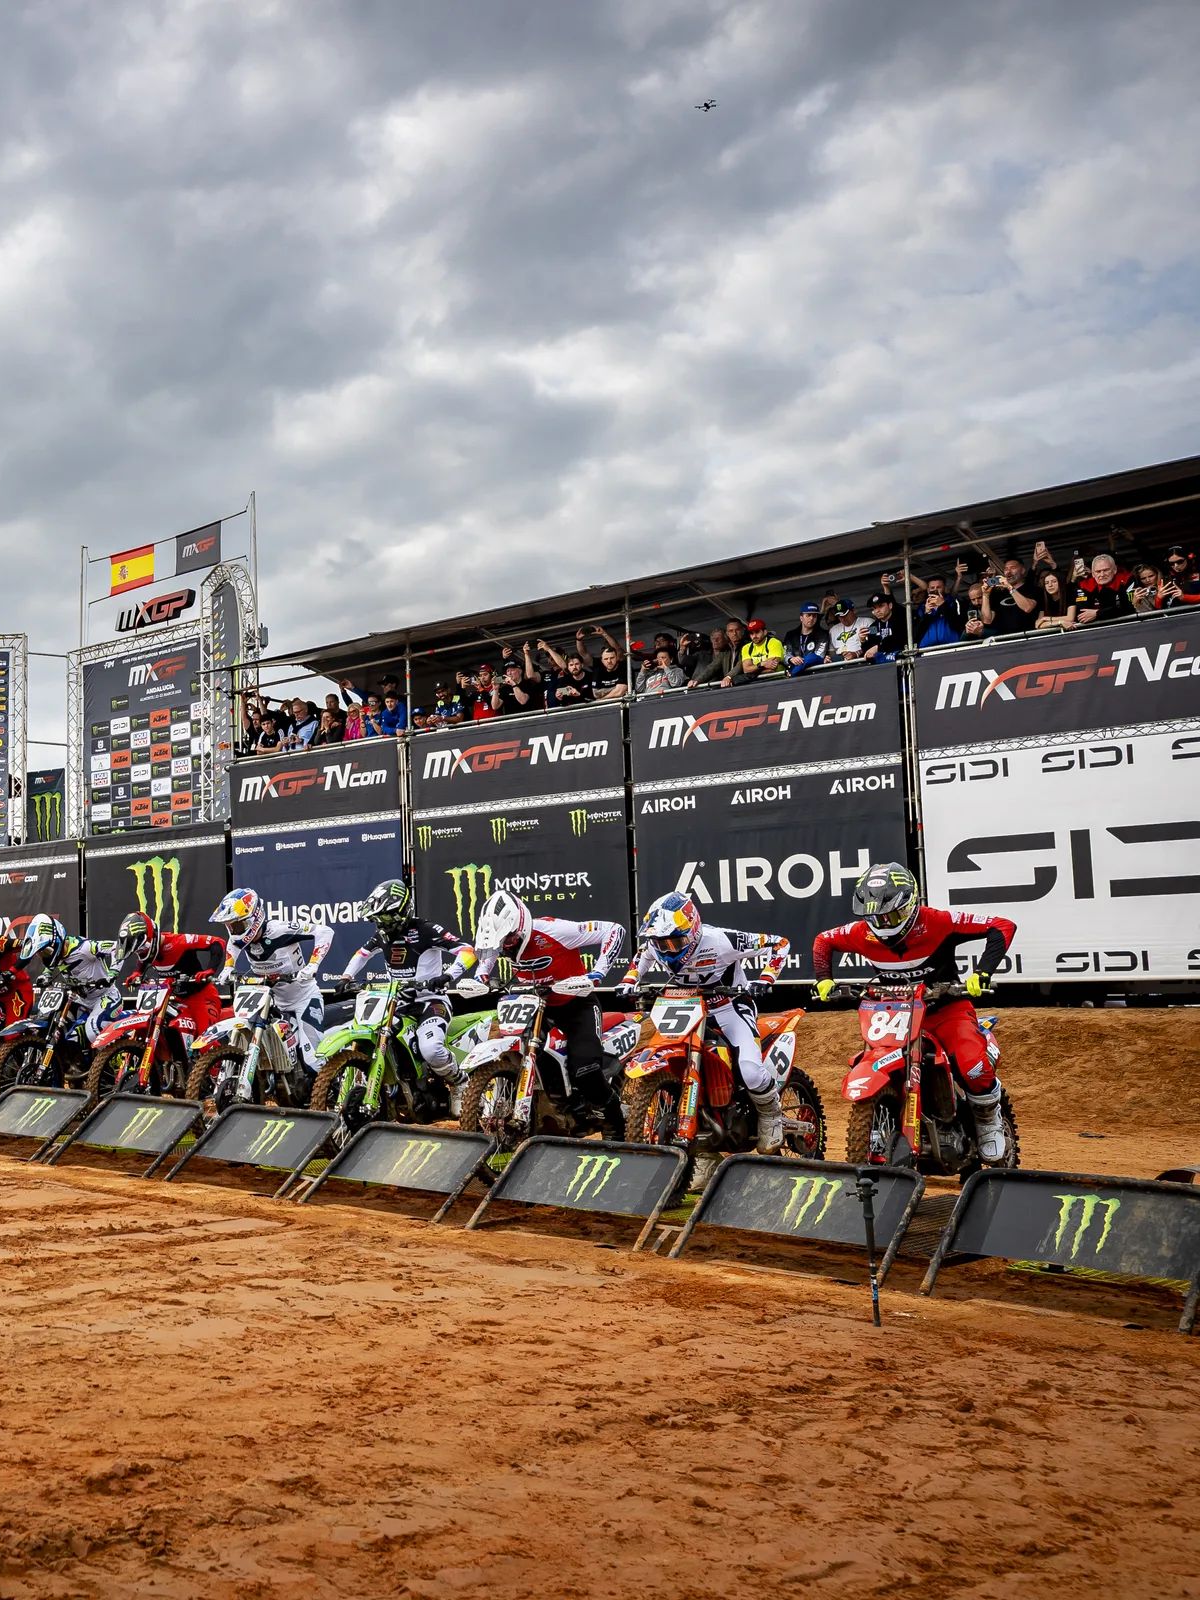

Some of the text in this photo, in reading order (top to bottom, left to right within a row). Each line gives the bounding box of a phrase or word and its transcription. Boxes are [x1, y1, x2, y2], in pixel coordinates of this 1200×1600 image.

[115, 588, 195, 631] MXGP
[146, 683, 175, 694] ANDALUCIA
[1042, 743, 1133, 773] SIDI
[926, 757, 1008, 785] SIDI
[830, 773, 895, 795] AIROH
[641, 795, 696, 815] AIROH
[731, 785, 791, 805] AIROH
[507, 819, 539, 828] MONSTER
[587, 810, 622, 820] MONSTER
[323, 836, 349, 846] Husqvarna
[367, 832, 396, 842] Husqvarna
[432, 827, 462, 836] MONSTER
[495, 872, 592, 892] MONSTER
[520, 892, 577, 902] NERGY
[1056, 950, 1149, 973] SIDI
[41, 991, 63, 1008] 959
[142, 991, 160, 1009] 16
[235, 992, 269, 1012] 74
[499, 1003, 536, 1024] 303
[659, 1006, 696, 1033] 5
[867, 1010, 911, 1041] 84
[612, 1030, 636, 1056] 303
[770, 1046, 790, 1076] 5
[373, 1064, 382, 1099] DUNLOP
